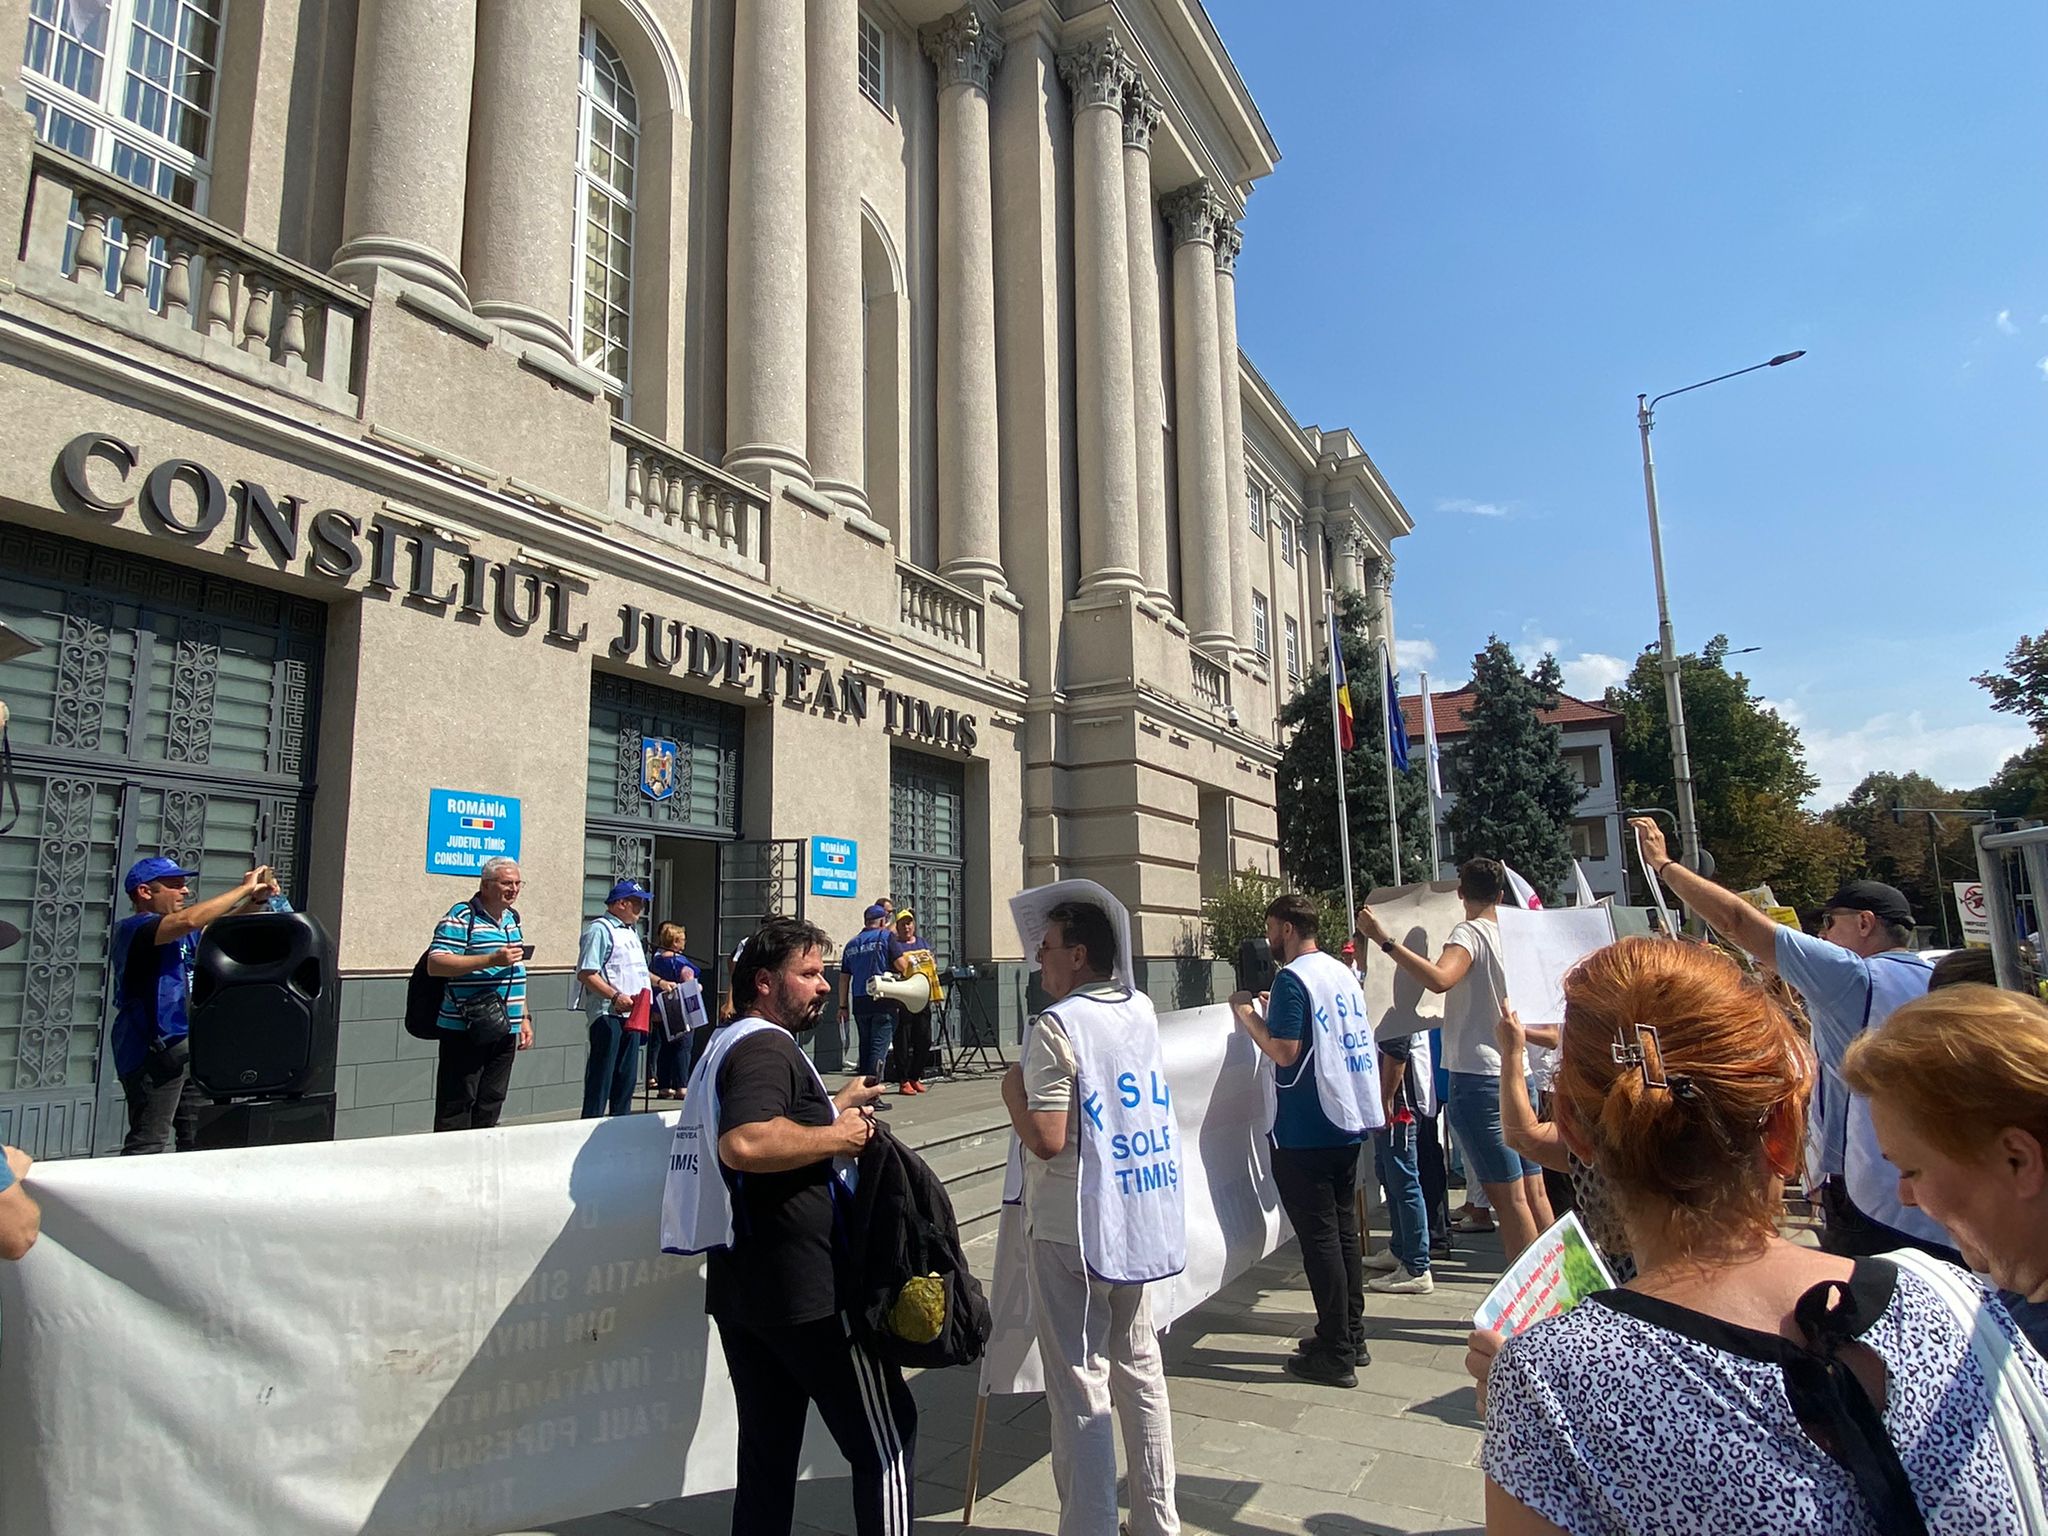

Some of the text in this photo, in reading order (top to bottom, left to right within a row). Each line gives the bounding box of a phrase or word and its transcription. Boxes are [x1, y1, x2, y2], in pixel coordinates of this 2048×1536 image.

[62, 432, 588, 643] CONSILIUL
[881, 688, 978, 758] TIMIȘ
[446, 835, 482, 851] JUDEȚUL
[434, 851, 475, 867] CONSILIUL
[670, 1153, 698, 1175] IMIȘ
[1115, 1160, 1178, 1195] TIMIȘ
